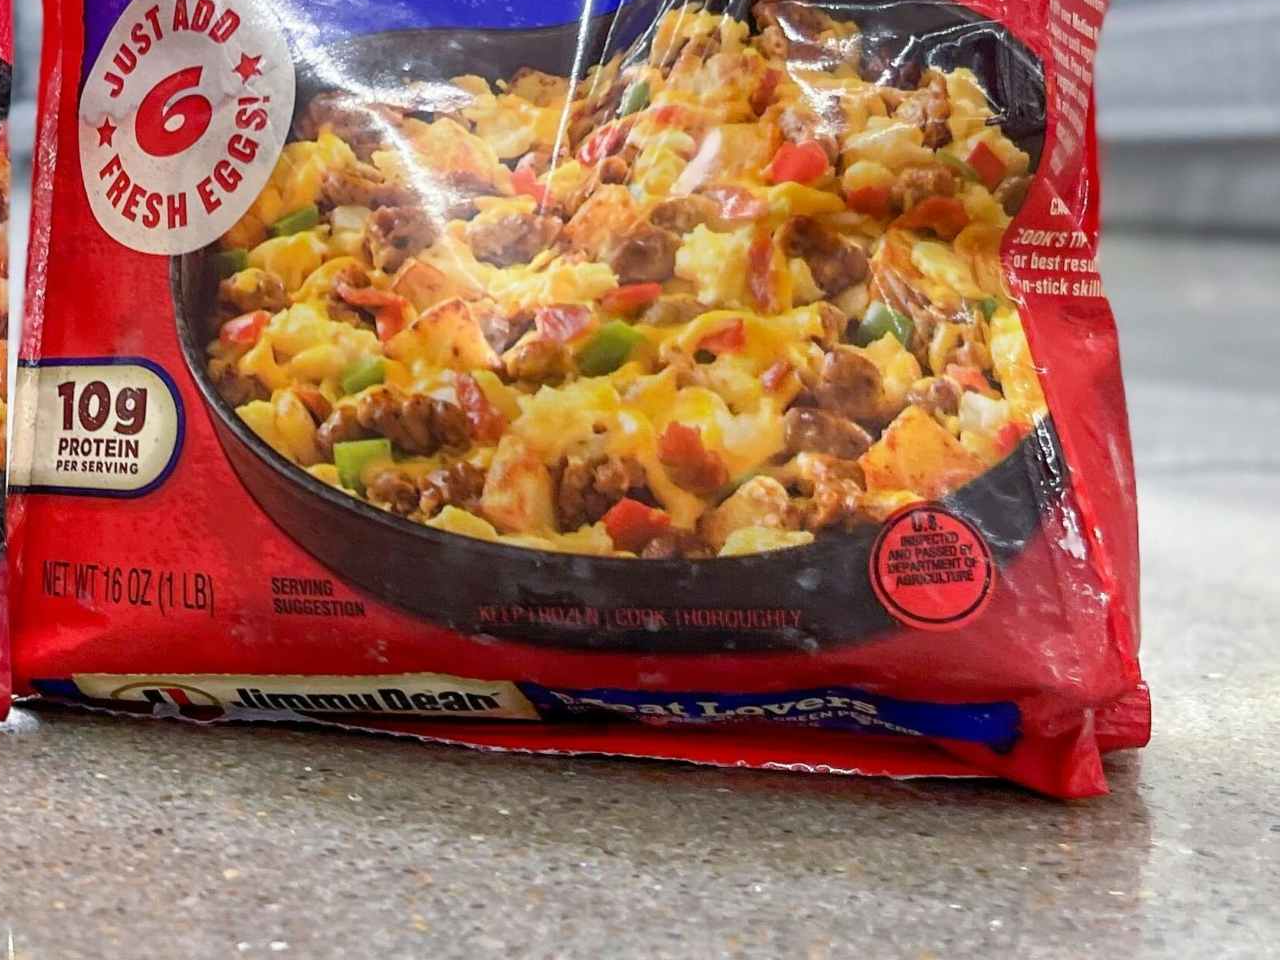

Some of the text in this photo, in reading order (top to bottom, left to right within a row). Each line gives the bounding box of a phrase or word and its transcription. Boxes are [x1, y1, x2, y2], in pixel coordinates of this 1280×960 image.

[103, 4, 164, 99] JUST
[134, 65, 213, 158] 6
[98, 95, 271, 230] FRESH EGGS!
[1030, 251, 1061, 271] best
[57, 380, 148, 436] 10g
[56, 459, 140, 476] PER SERVING
[57, 438, 140, 459] PROTEIN
[42, 560, 69, 596] NET
[104, 565, 122, 604] 16
[128, 567, 153, 607] OZ
[158, 568, 175, 616] (1
[182, 571, 215, 618] LB)
[271, 577, 334, 596] SERVING
[273, 599, 367, 618] SUGGESTION
